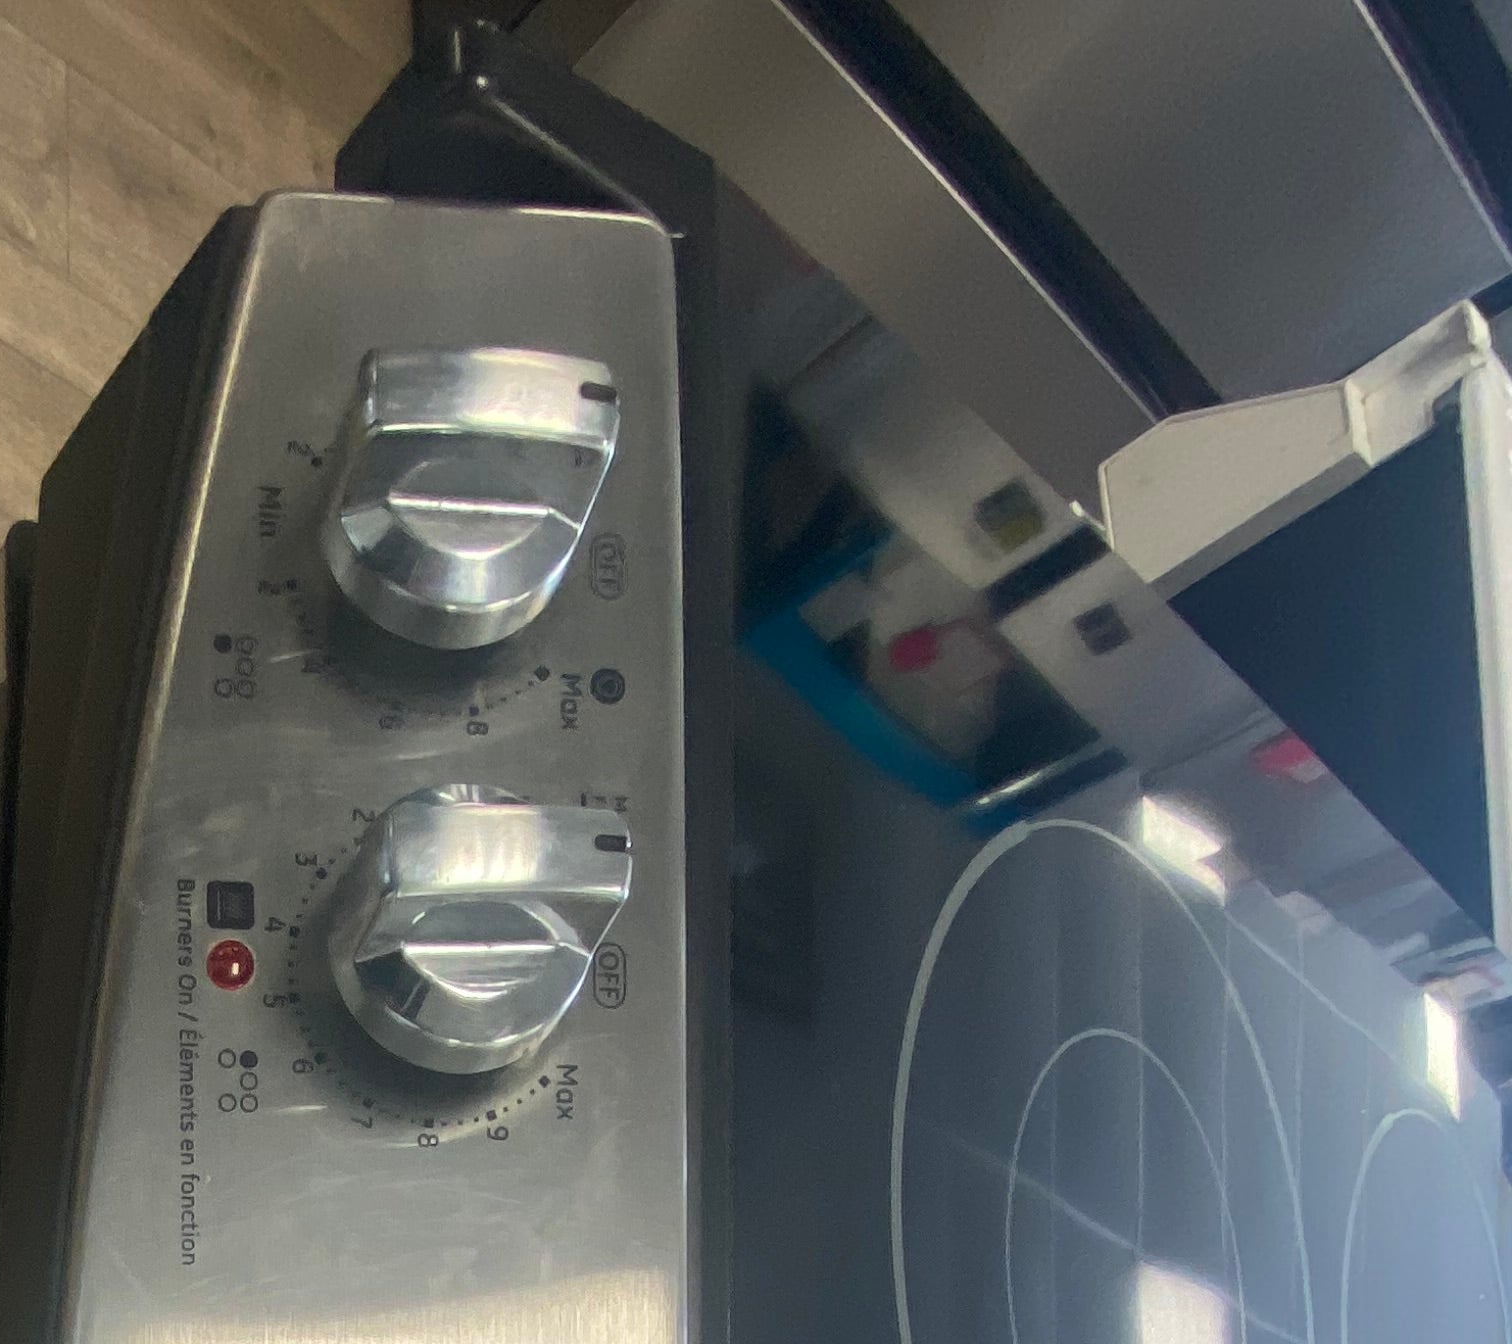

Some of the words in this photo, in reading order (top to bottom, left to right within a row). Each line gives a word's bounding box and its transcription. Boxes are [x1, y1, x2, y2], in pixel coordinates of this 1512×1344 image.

[257, 485, 287, 539] Min
[598, 543, 621, 590] OFF
[560, 673, 583, 730] Max
[466, 721, 490, 737] 8
[352, 808, 376, 823] 2
[177, 878, 197, 967] Burners
[264, 916, 287, 933] 4
[177, 974, 197, 1005] On
[598, 951, 621, 1000] OFF
[178, 1028, 205, 1133] Éléments
[292, 1058, 314, 1074] 6
[555, 1064, 579, 1121] Max
[351, 1115, 373, 1129] 7
[485, 1125, 509, 1142] 9
[179, 1138, 196, 1167] en
[417, 1132, 440, 1149] 8
[179, 1172, 200, 1267] fonction
